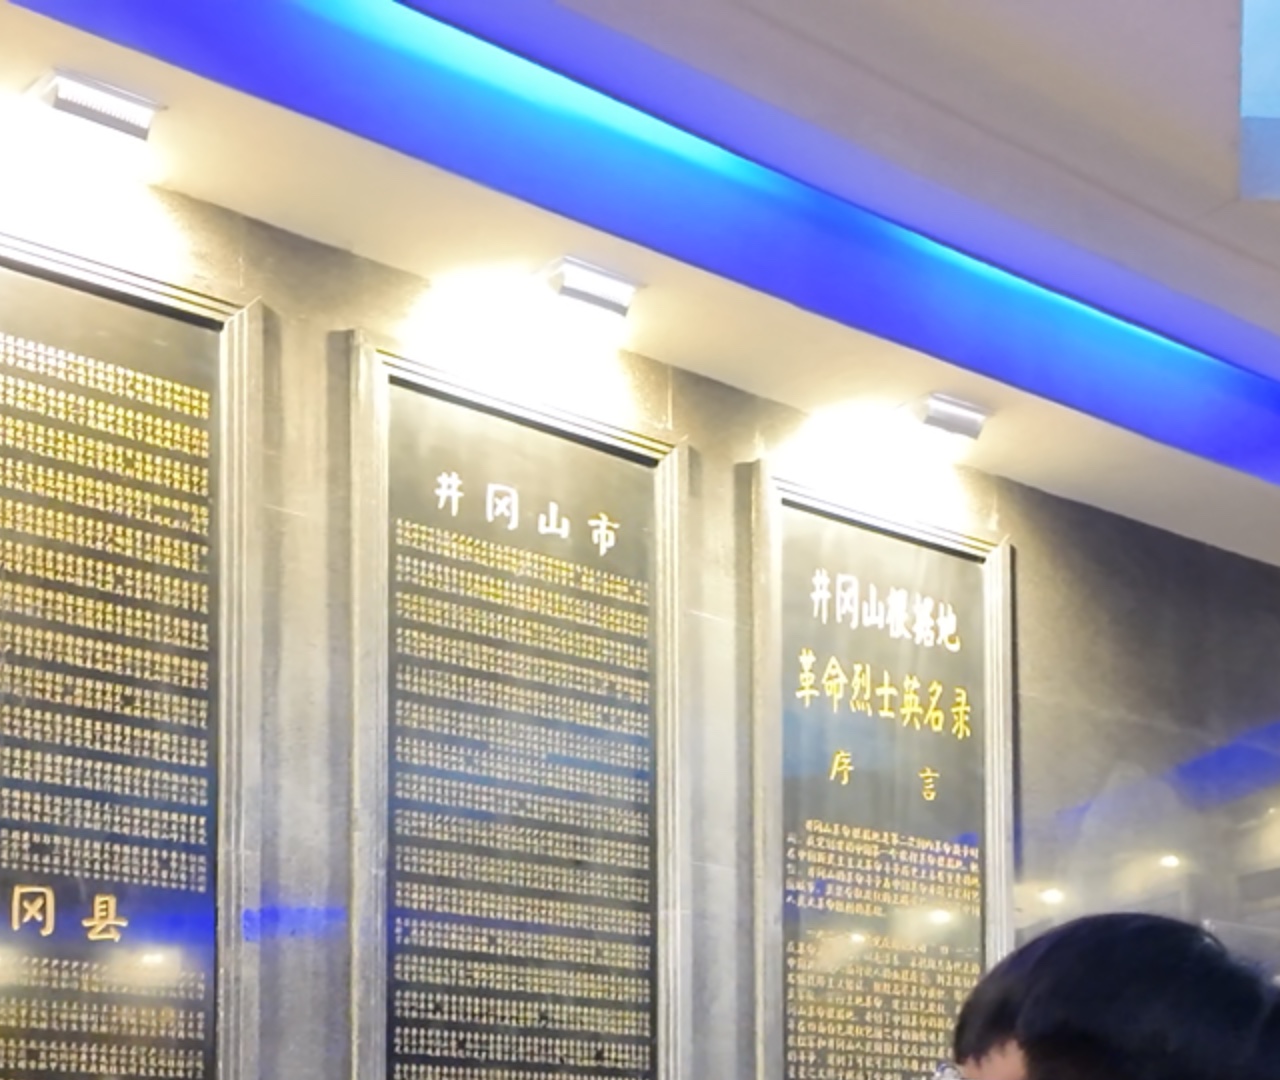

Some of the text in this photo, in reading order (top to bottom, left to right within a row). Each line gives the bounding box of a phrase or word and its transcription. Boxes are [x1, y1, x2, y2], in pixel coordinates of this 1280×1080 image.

[434, 471, 621, 557] 井冈山市
[809, 568, 961, 652] 井冈山根据地
[795, 647, 972, 740] 革命烈士英名录
[829, 748, 941, 802] 序言
